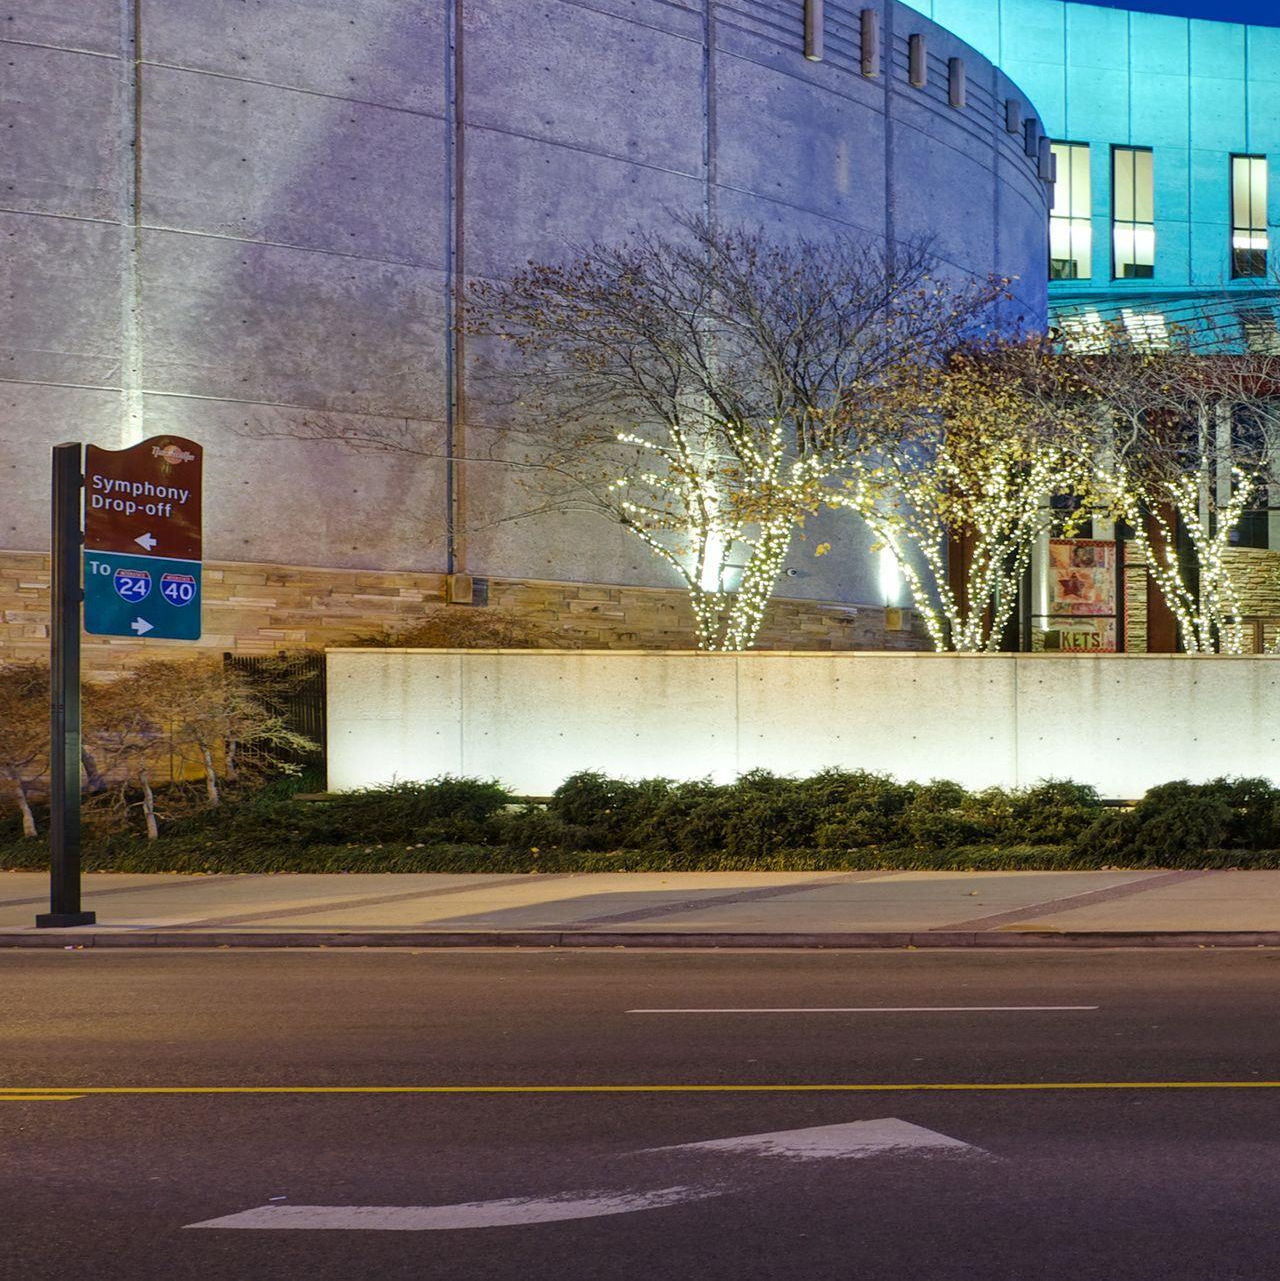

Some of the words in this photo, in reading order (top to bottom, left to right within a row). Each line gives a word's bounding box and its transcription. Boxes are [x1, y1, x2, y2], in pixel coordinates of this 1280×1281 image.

[92, 475, 189, 504] Symphony
[92, 494, 173, 517] Drop-off
[89, 561, 111, 576] To
[120, 578, 147, 596] 24
[164, 583, 193, 601] 40
